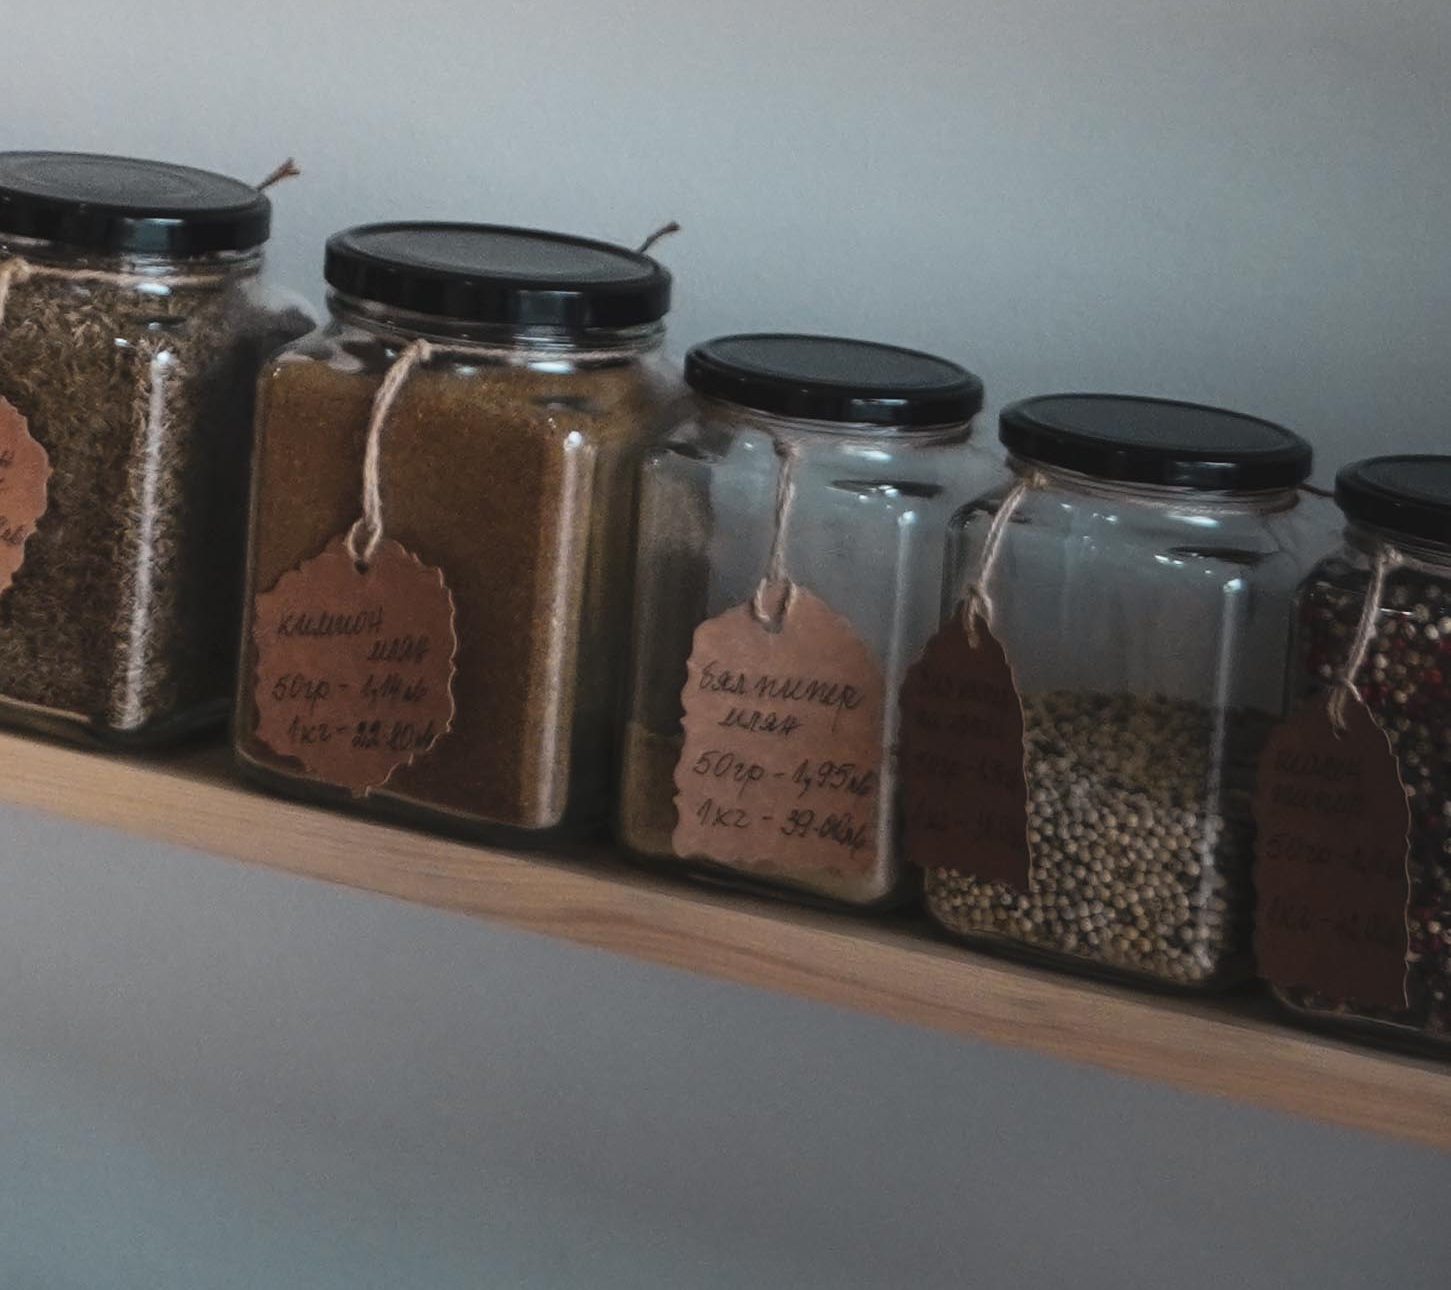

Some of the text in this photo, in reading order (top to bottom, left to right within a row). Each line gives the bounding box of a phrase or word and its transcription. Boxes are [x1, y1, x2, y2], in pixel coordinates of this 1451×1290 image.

[277, 605, 383, 637] кимион
[700, 660, 867, 726] бял пипер
[719, 708, 802, 736] млян
[693, 750, 766, 795] 50гр
[697, 798, 749, 828] 1кг
